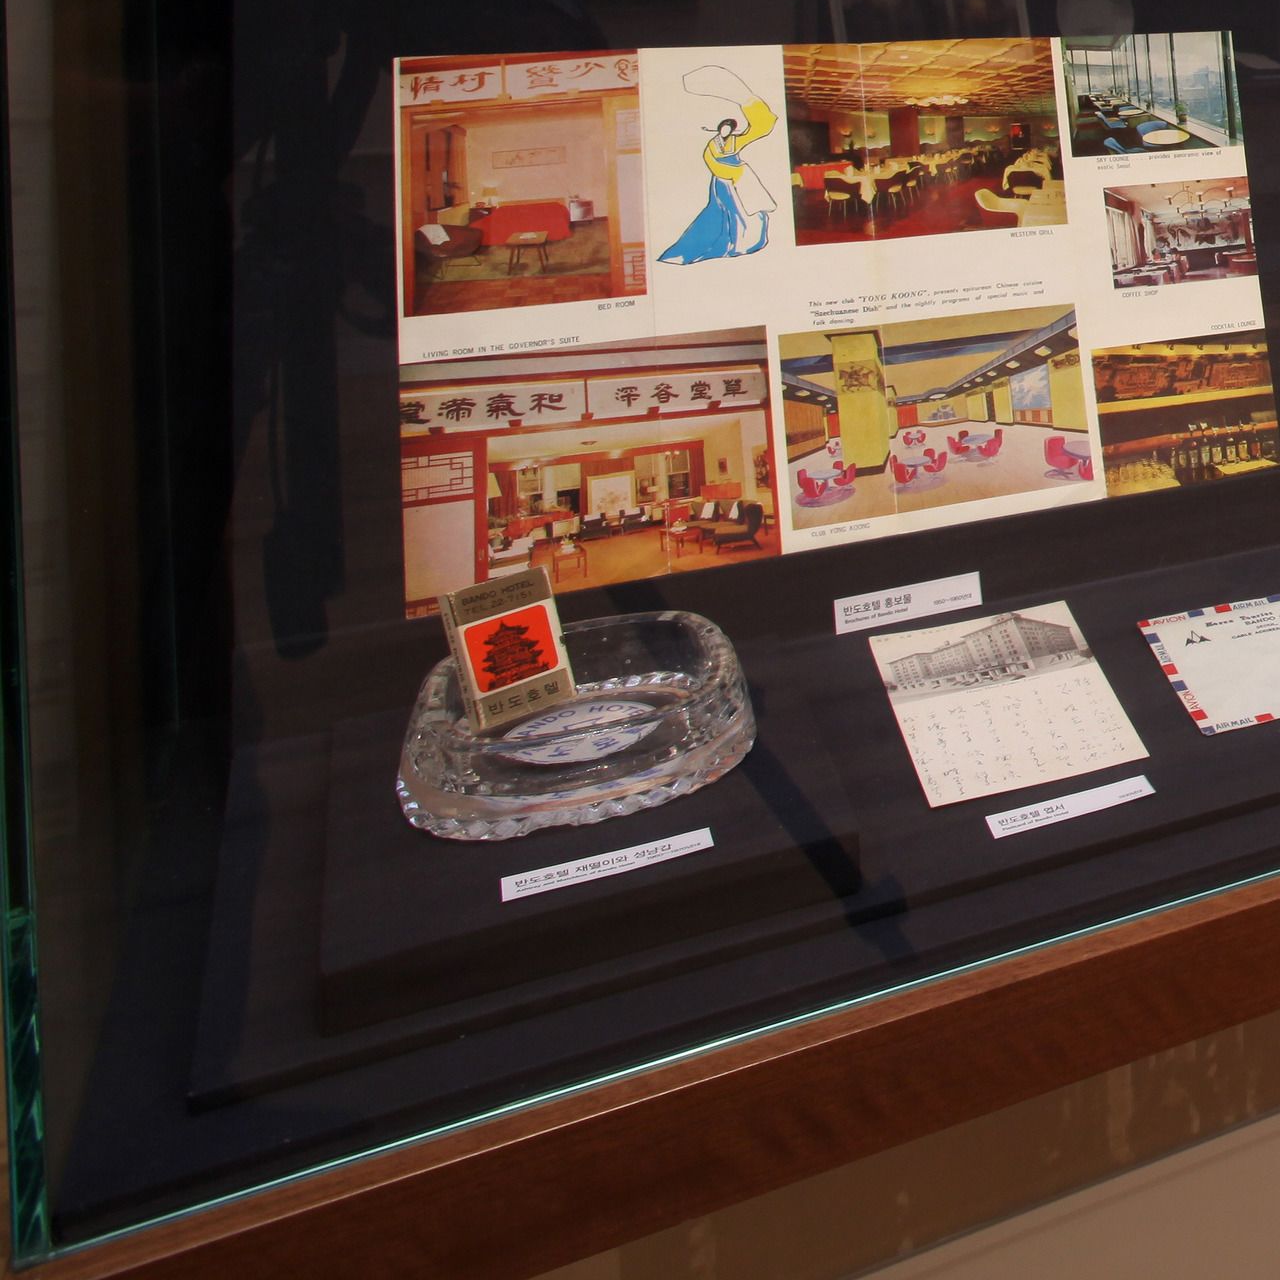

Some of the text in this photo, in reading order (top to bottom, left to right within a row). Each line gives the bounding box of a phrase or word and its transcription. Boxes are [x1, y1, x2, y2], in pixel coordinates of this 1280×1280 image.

[423, 350, 448, 358] LIVING
[559, 336, 579, 344] SUITE
[462, 580, 535, 606] BANDO HOTEL
[843, 600, 880, 617] 반도호텔
[1245, 616, 1276, 626] BANDO
